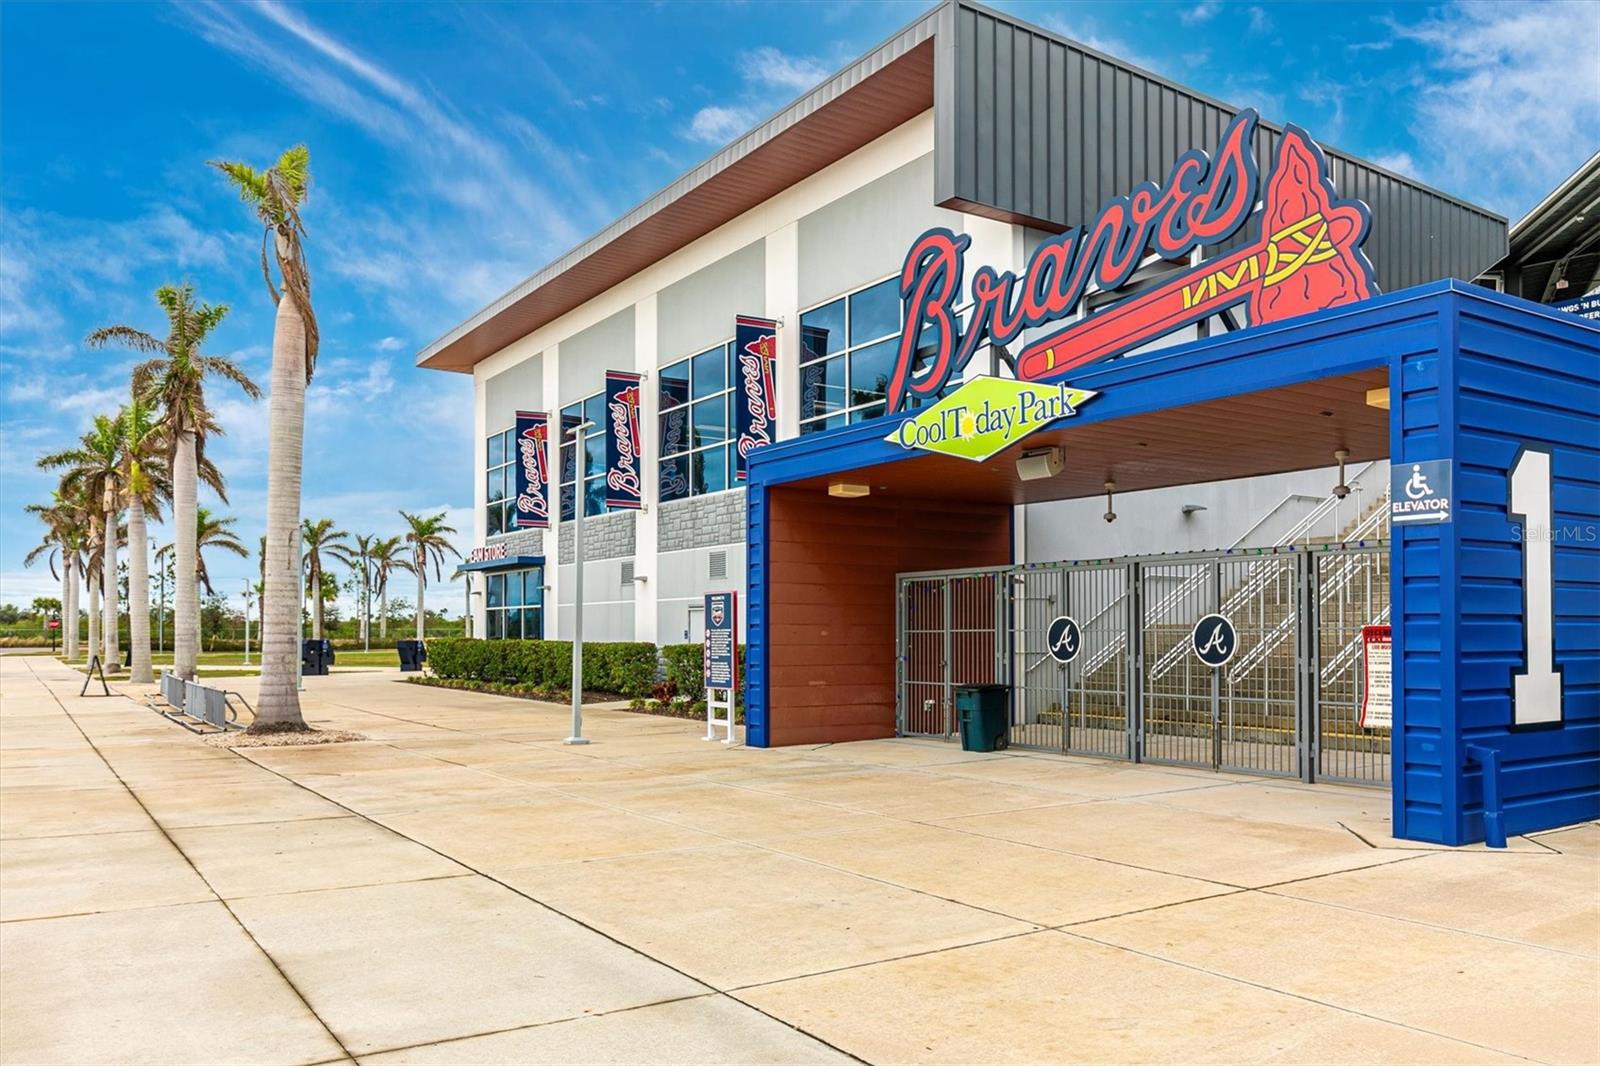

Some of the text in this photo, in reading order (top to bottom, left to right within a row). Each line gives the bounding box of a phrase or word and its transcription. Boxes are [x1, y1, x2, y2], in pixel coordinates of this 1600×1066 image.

[889, 107, 1259, 417] Braves
[1557, 303, 1579, 313] WGS
[1018, 382, 1077, 425] Park
[608, 402, 641, 497] Braves
[517, 438, 549, 517] Braves
[1393, 498, 1449, 513] ELEVATOR
[1508, 446, 1563, 730] 1
[1051, 624, 1075, 652] A
[1199, 623, 1227, 655] A
